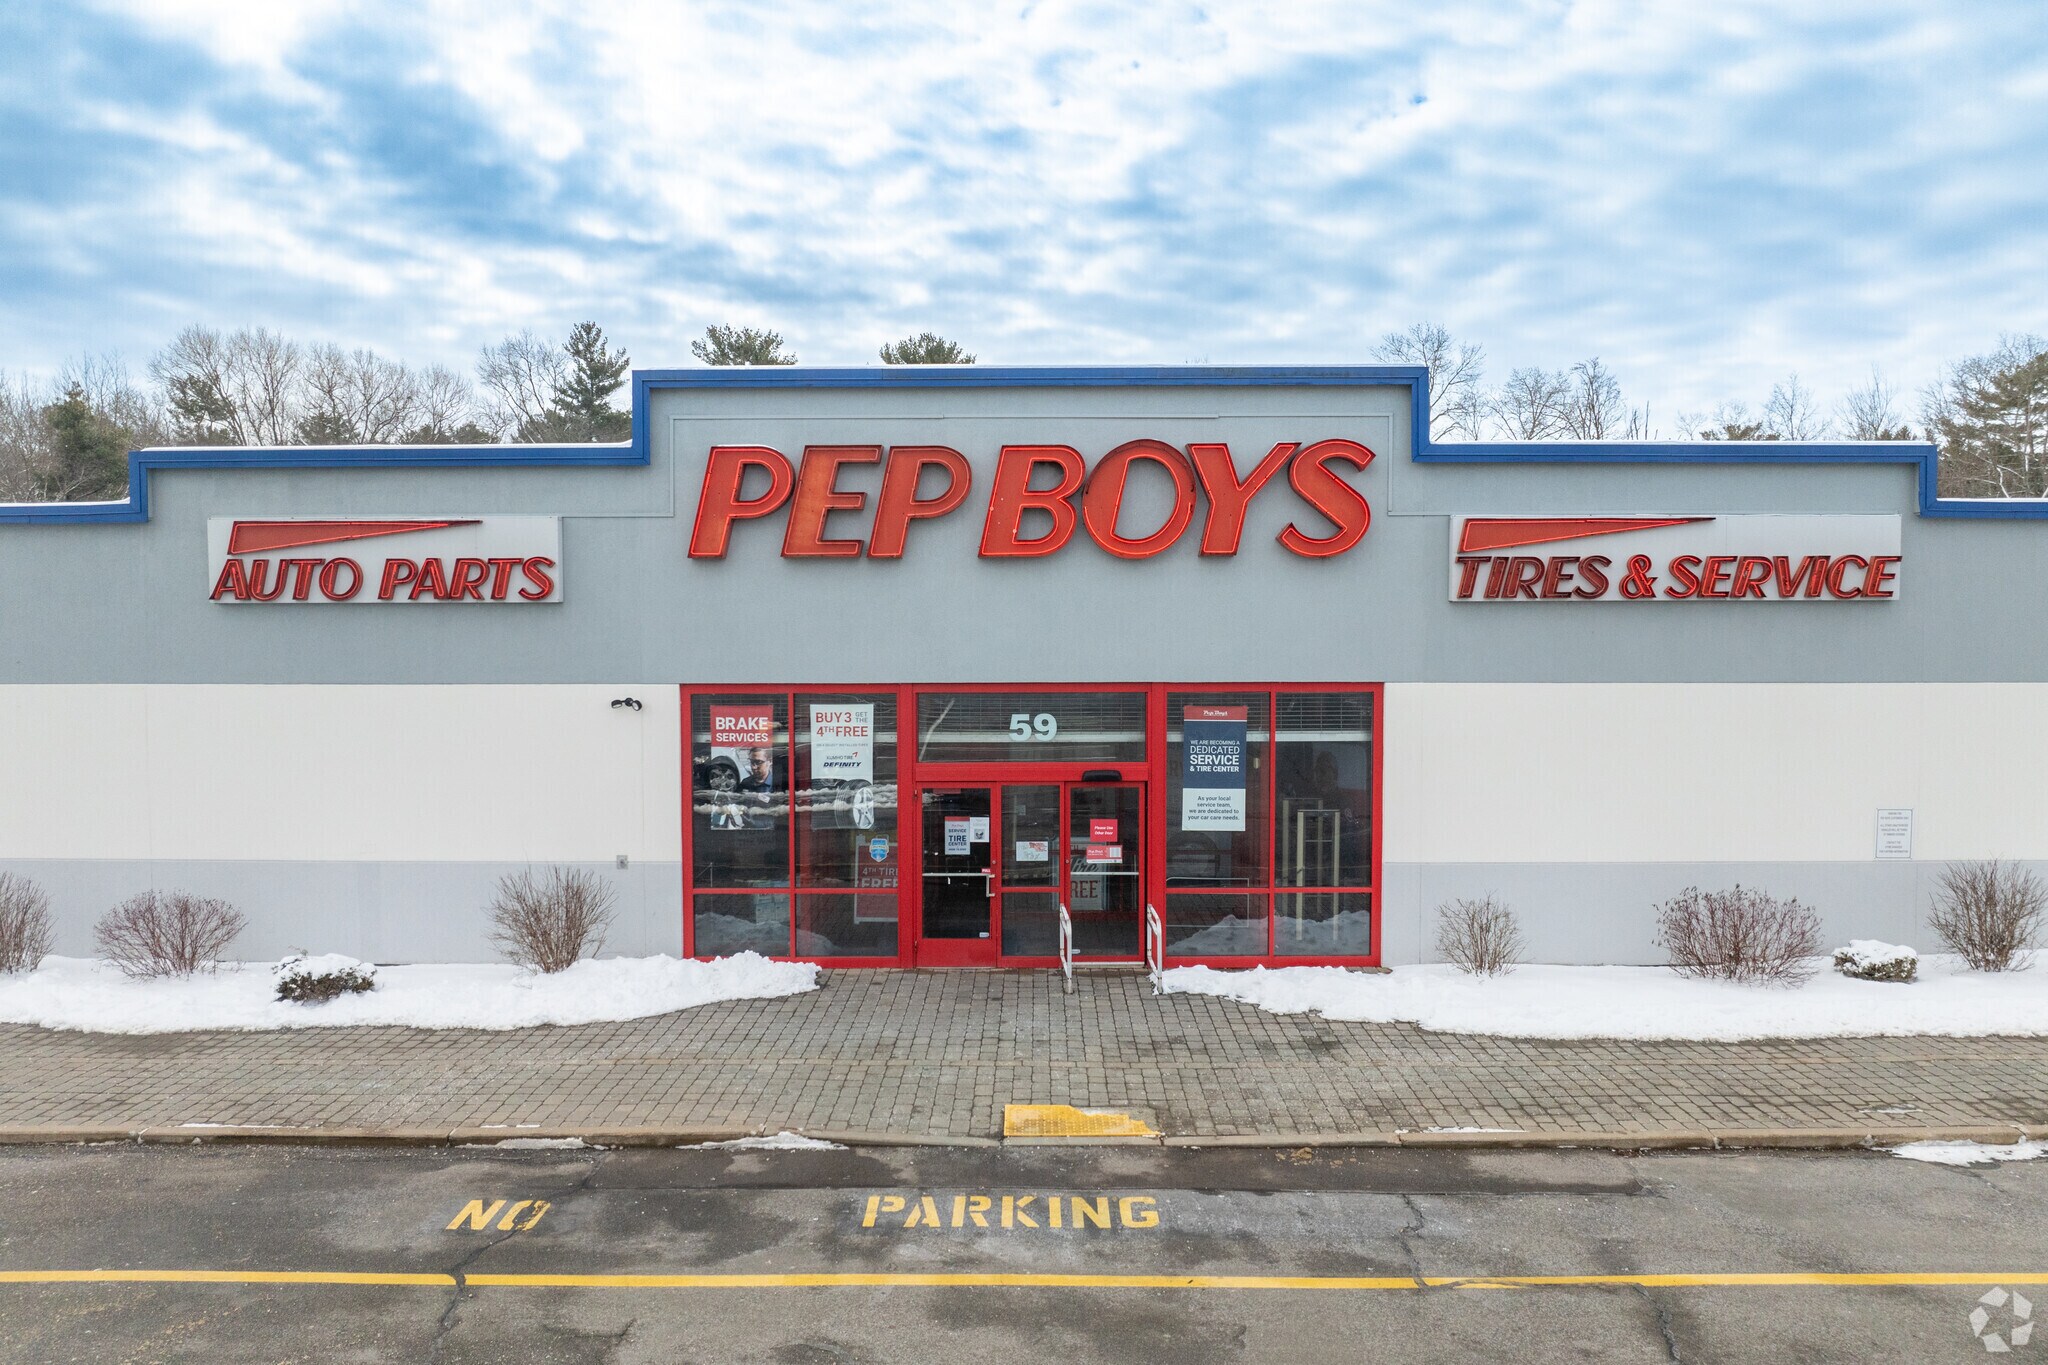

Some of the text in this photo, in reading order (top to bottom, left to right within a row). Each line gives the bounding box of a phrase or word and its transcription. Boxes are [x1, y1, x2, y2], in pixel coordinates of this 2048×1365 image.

[688, 438, 1377, 559] PEP BOYS
[209, 556, 556, 601] AUTO PARTS
[1456, 553, 1903, 599] TIRES & SERVICE
[715, 716, 769, 730] BRAKE
[815, 712, 852, 723] BUY 3
[835, 726, 868, 737] FREE
[1008, 713, 1057, 741] 59
[715, 732, 768, 742] SERVICES
[1190, 745, 1240, 754] DEDICATED
[1189, 754, 1240, 765] SERVICE
[1070, 880, 1098, 898] REE
[445, 1195, 1160, 1231] NO PARKING
